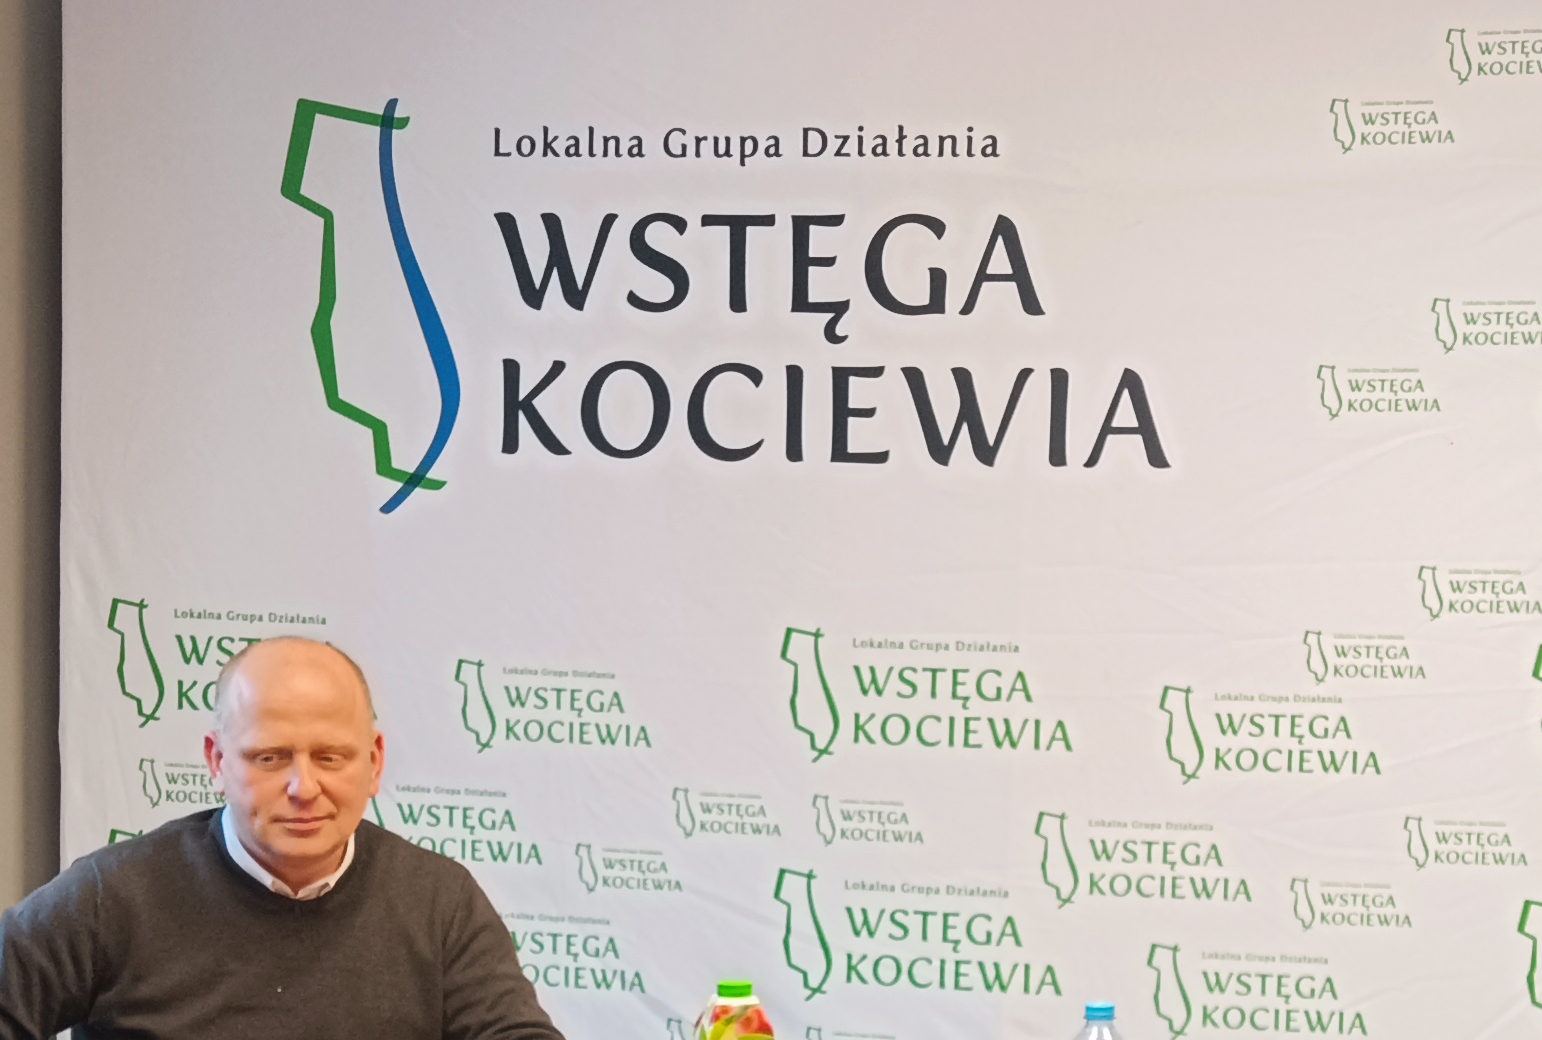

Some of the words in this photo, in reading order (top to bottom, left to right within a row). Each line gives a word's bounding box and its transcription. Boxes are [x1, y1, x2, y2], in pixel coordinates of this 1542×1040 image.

[1361, 111, 1438, 128] WSTĘGA
[494, 126, 645, 158] Lokalna
[663, 128, 782, 167] Grupa
[802, 125, 1000, 158] Działania
[1360, 130, 1455, 145] KOCIEWIA
[494, 212, 1045, 344] WSTĘGA
[1463, 311, 1541, 329] WSTĘGA
[1348, 379, 1424, 396] WSTĘGA
[501, 358, 1170, 468] KOCIEWIA
[1348, 398, 1441, 412] KOCIEWIA
[1449, 580, 1526, 598] WSTĘGA
[174, 608, 222, 620] Lokalna
[226, 610, 263, 624] Grupa
[268, 612, 327, 625] Działania
[1448, 600, 1542, 614] KOCIEWIA
[852, 638, 904, 650] Lokalna
[909, 639, 950, 653] Grupa
[955, 640, 1020, 653] Działania
[1334, 645, 1409, 663] WSTĘGA
[1333, 664, 1426, 679] KOCIEWIA
[853, 665, 1033, 710] WSTĘGA
[504, 685, 625, 718] WSTĘGA
[506, 718, 651, 748] KOCIEWIA
[853, 712, 1072, 752] KOCIEWIA
[1215, 713, 1352, 745] WSTĘGA
[1215, 747, 1381, 775] KOCIEWIA
[164, 791, 226, 804] KOCIEW
[397, 803, 516, 835] WSTĘGA
[700, 802, 766, 820] WSTĘGA
[840, 809, 909, 827] WSTĘGA
[700, 820, 781, 836] KOCIEWIA
[840, 828, 924, 844] KOCIEWIA
[1435, 831, 1511, 850] WSTĘGA
[401, 837, 543, 865] OCIEWIA
[1089, 838, 1223, 871] WSTĘGA
[1434, 850, 1528, 866] KOCIEWIA
[602, 858, 668, 875] WSTĘGA
[602, 876, 683, 892] KOCIEWIA
[844, 880, 895, 893] Lokalna
[901, 882, 940, 896] Grupa
[945, 885, 1009, 899] Działania
[1089, 872, 1252, 902] KOCIEWIA
[1321, 893, 1396, 912] WSTĘGA
[845, 906, 1022, 953] WSTĘGA
[1320, 912, 1412, 928] KOCIEWIA
[521, 965, 646, 993] OCIEWIA
[846, 953, 1062, 996] KOCIEWIA
[1202, 971, 1338, 1005] WSTĘGA
[1202, 1005, 1367, 1036] KOCIEWIA
